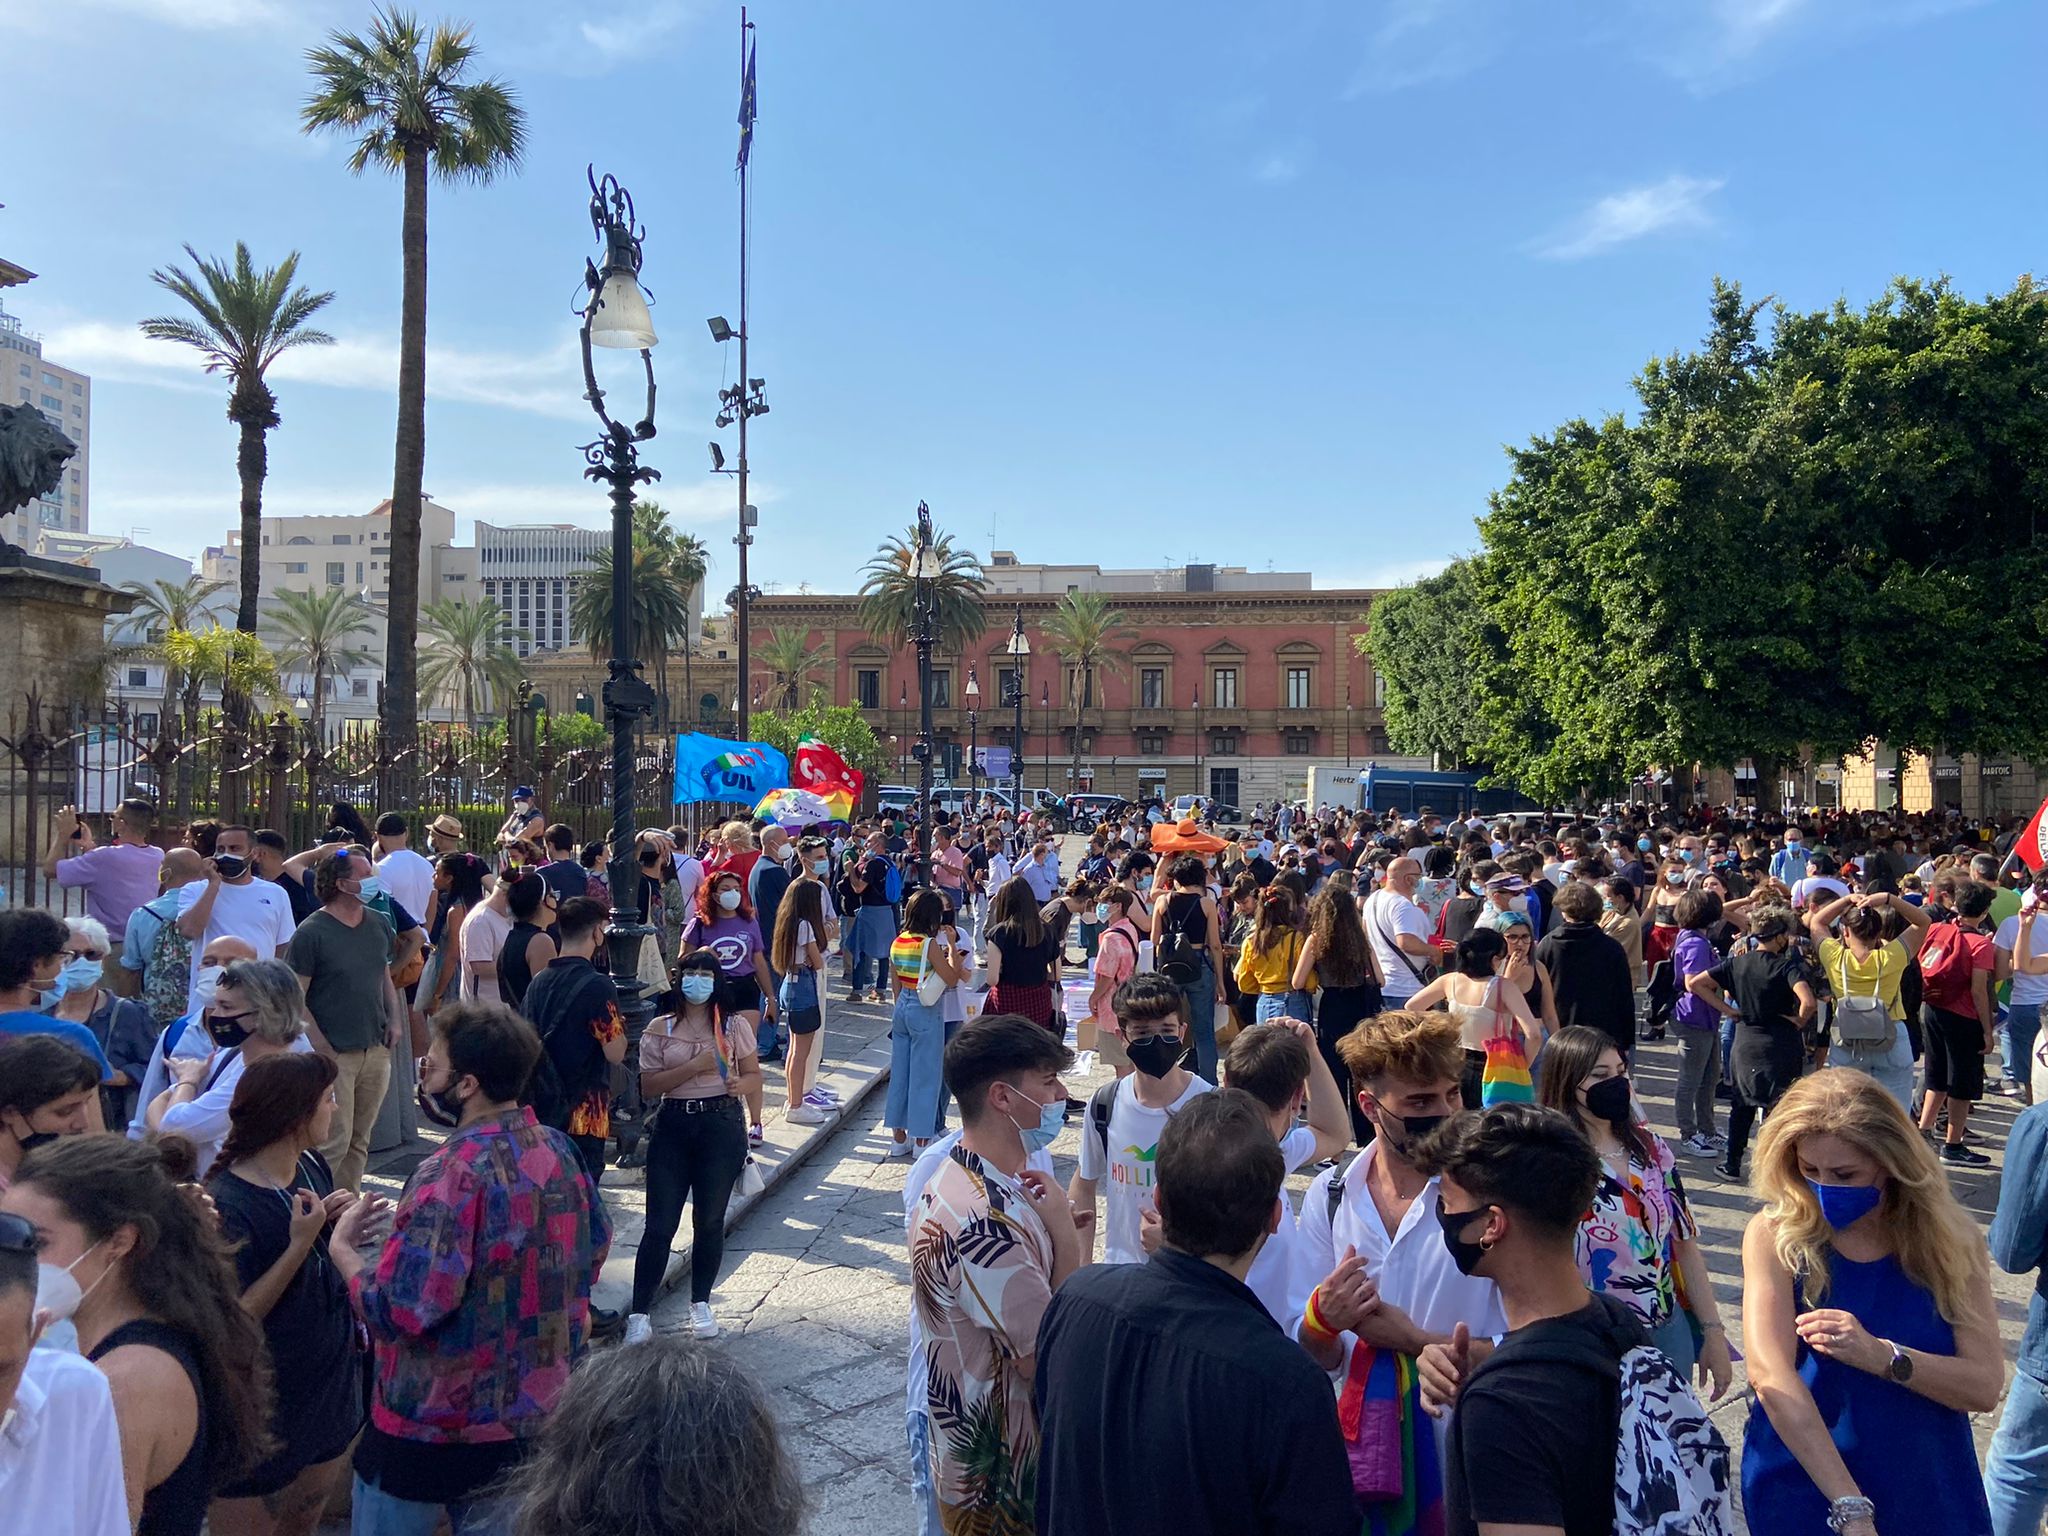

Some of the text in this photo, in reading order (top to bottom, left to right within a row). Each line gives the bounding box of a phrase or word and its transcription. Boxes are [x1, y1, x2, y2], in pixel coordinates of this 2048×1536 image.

[722, 771, 756, 792] UIL
[1332, 776, 1355, 784] Hertz
[1112, 1161, 1151, 1187] HOLLI
